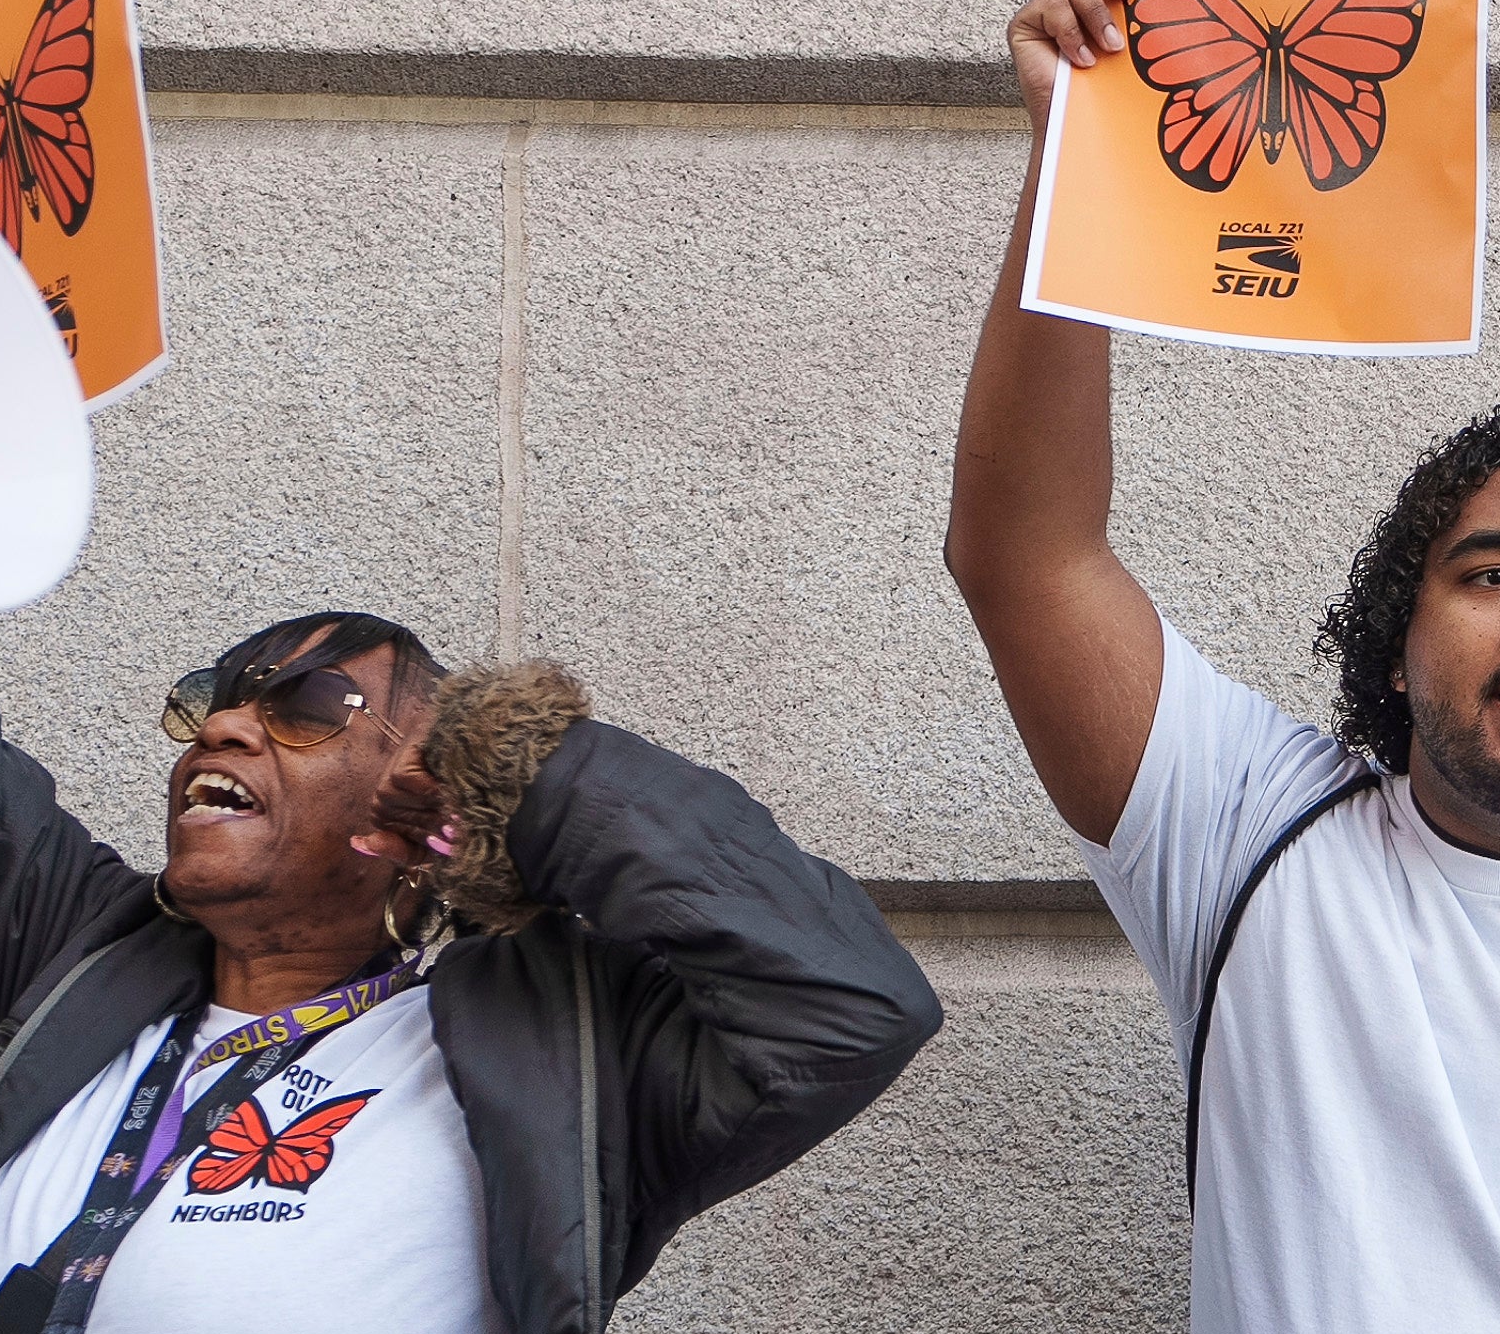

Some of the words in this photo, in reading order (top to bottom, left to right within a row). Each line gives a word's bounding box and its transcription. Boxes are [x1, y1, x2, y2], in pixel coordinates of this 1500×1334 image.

[1219, 222, 1272, 234] LOCAL
[1278, 223, 1304, 234] 721
[1211, 273, 1300, 299] SEIU
[194, 1015, 290, 1072] STRON
[242, 1039, 294, 1083] ZIP
[123, 1084, 161, 1131] ZIPS
[281, 1088, 314, 1113] OU
[170, 1201, 308, 1223] NEIGHBORS
